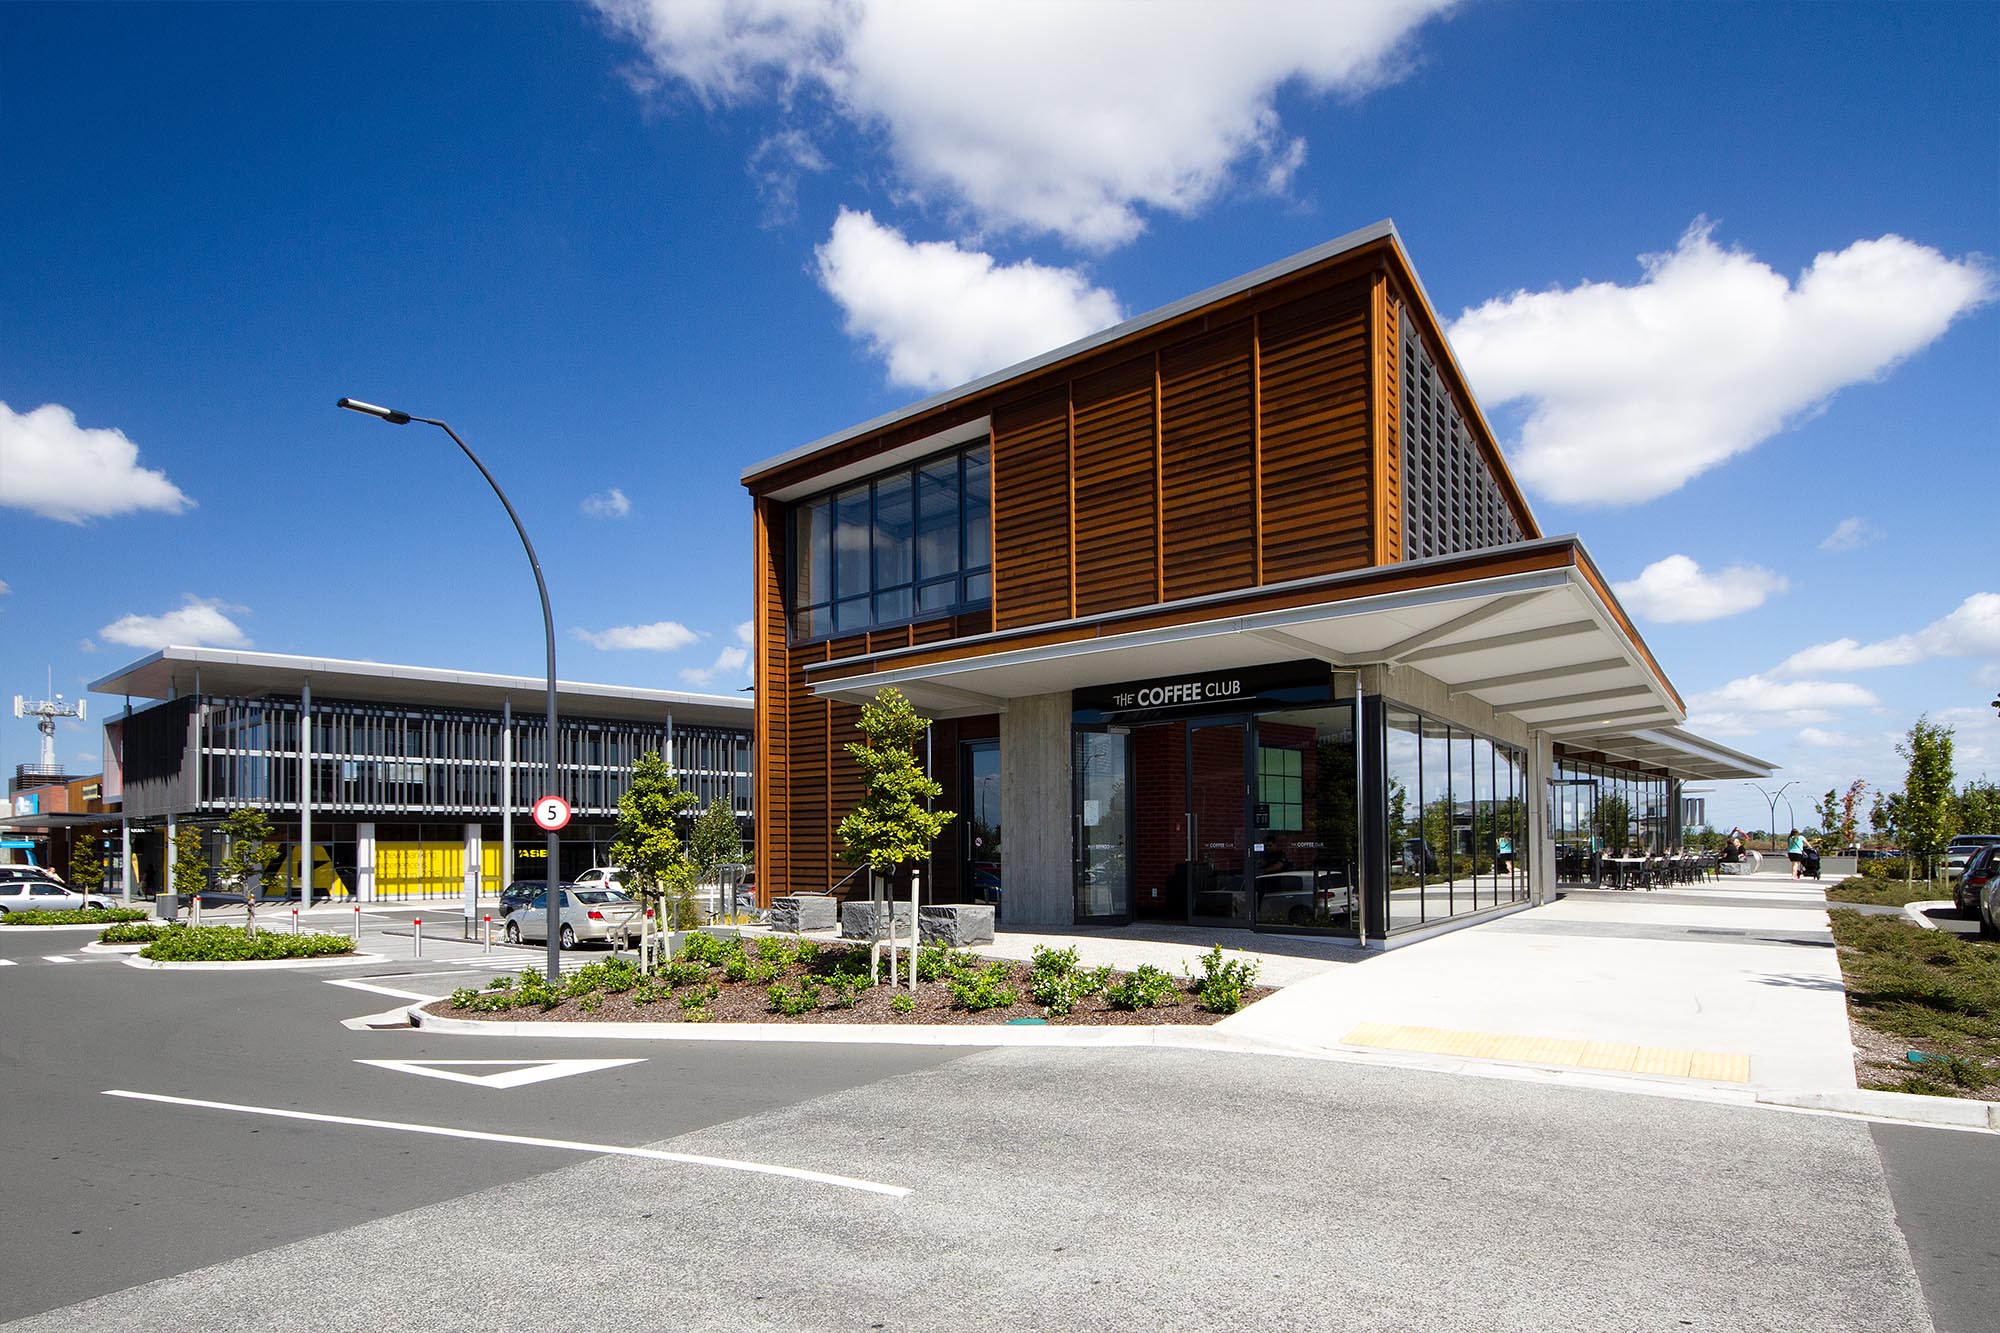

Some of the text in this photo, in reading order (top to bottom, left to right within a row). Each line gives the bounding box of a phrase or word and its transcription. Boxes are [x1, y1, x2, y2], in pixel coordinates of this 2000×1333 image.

[1113, 680, 1241, 707] THE COFFEE CLUB
[547, 805, 557, 820] 5
